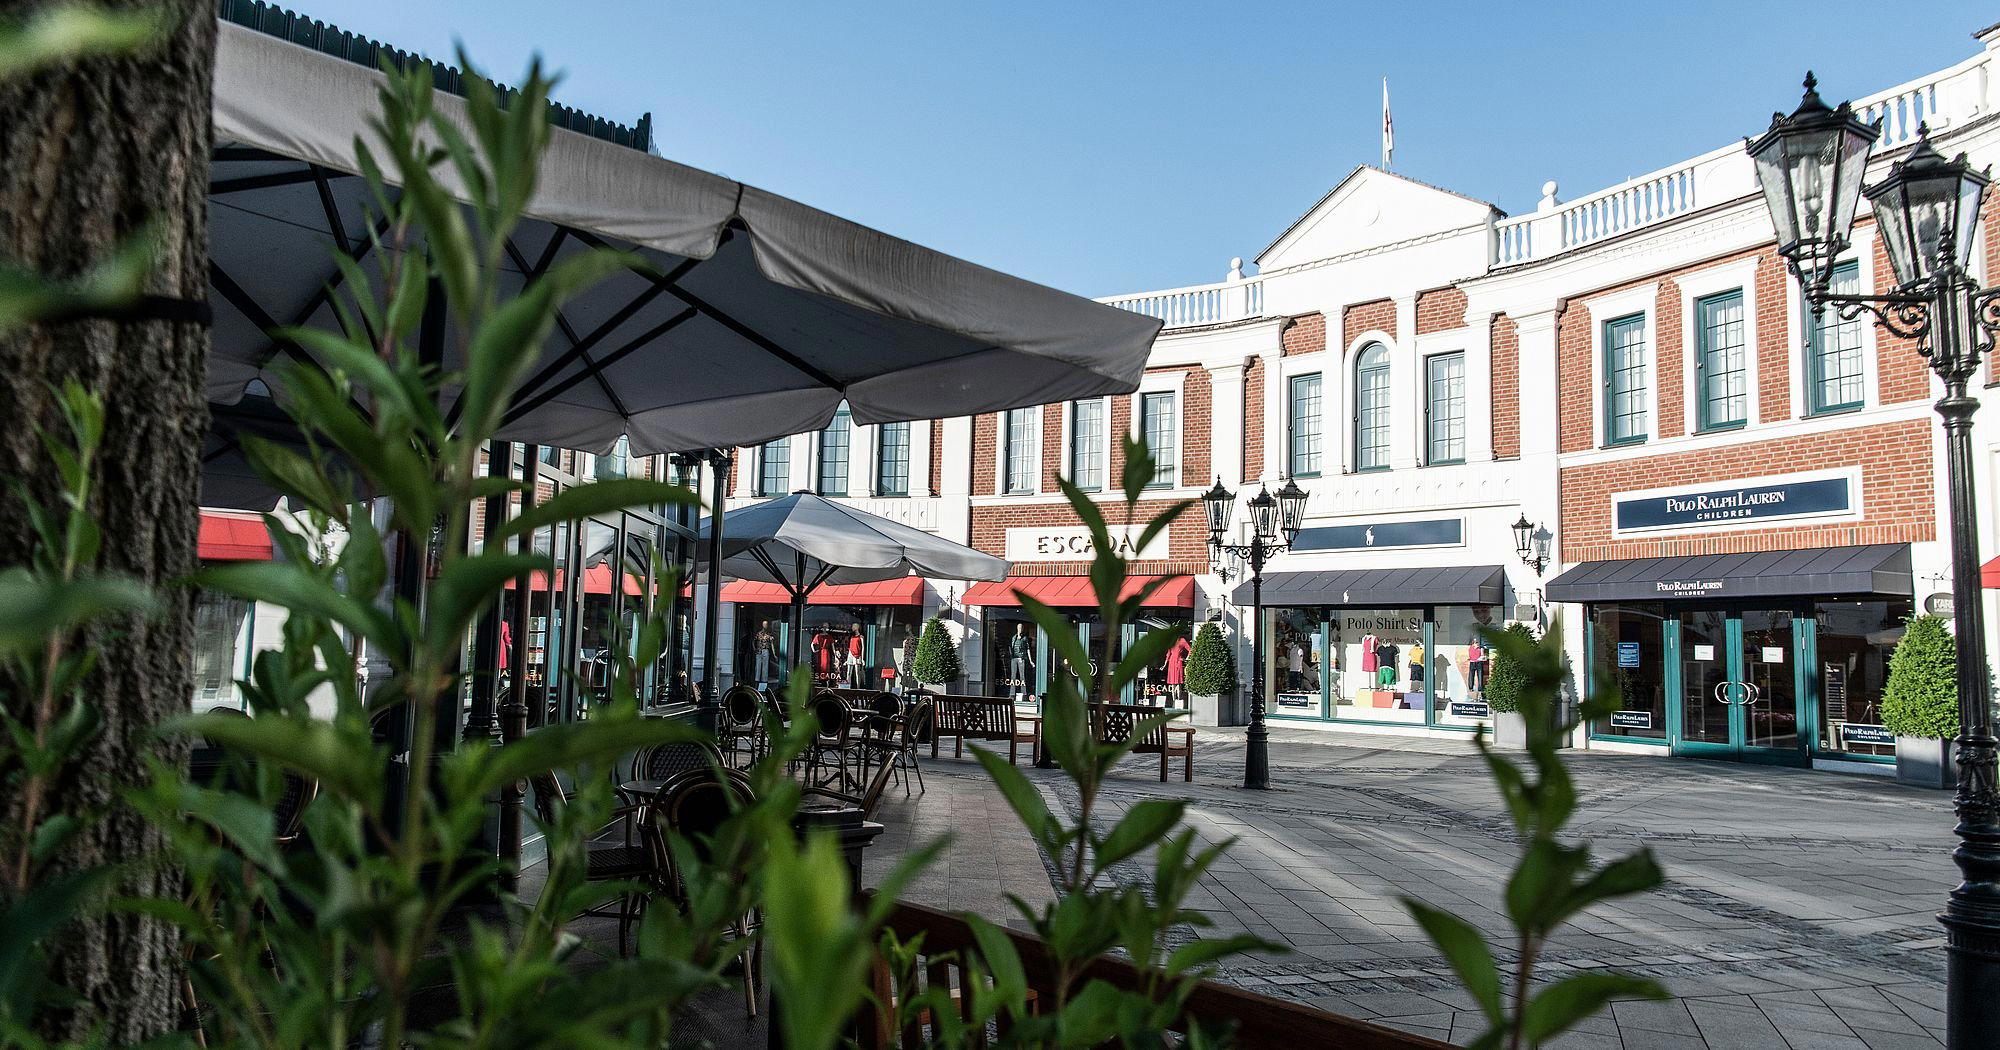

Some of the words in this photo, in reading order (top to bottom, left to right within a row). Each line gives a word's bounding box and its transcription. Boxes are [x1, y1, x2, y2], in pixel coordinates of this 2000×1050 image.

[1666, 499, 1695, 513] POLO
[1697, 495, 1737, 510] RALPH
[1738, 491, 1785, 507] LAUREN
[1697, 509, 1752, 520] CHILDREN
[1657, 582, 1674, 591] POLO
[1674, 581, 1696, 591] RALPH
[1697, 580, 1723, 590] LAUREN
[1347, 617, 1372, 630] Polo
[1376, 617, 1406, 630] Shirt
[1409, 617, 1443, 633] Sty
[1146, 684, 1180, 692] ESCADA
